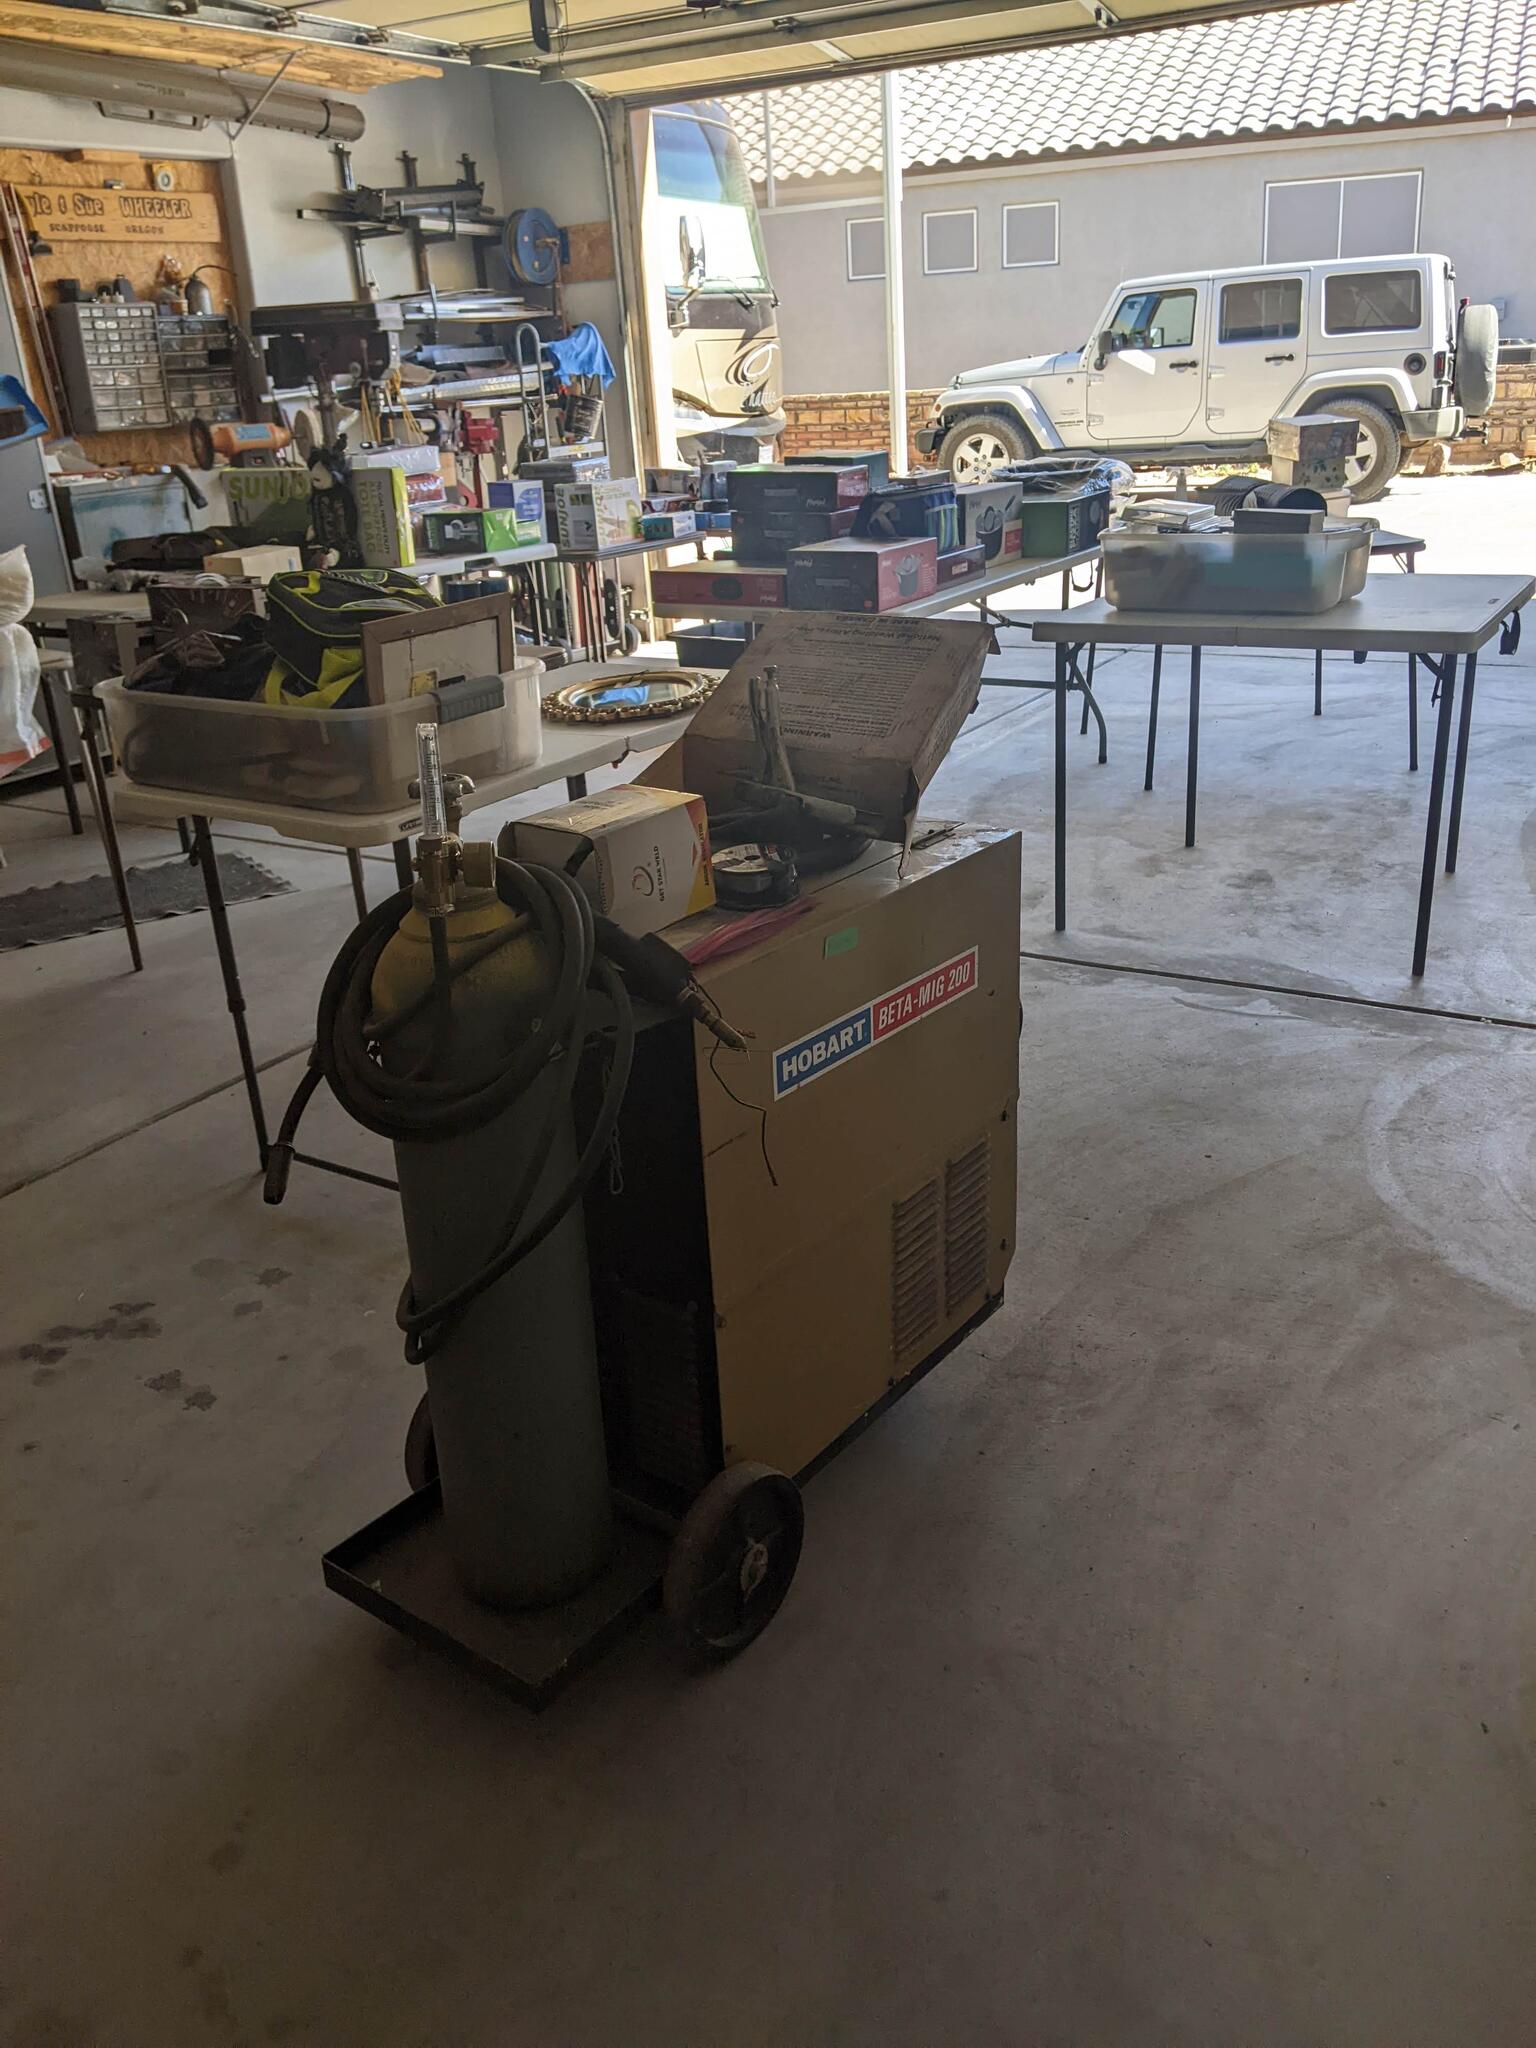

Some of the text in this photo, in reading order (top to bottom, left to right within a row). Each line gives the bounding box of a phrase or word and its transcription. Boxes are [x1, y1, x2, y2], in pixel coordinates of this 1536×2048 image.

[73, 192, 104, 216] Sue
[119, 195, 192, 219] WHEELER
[782, 726, 832, 739] WARNIN
[878, 961, 971, 1030] BETA-MIG 200
[782, 1018, 867, 1082] HOBART
